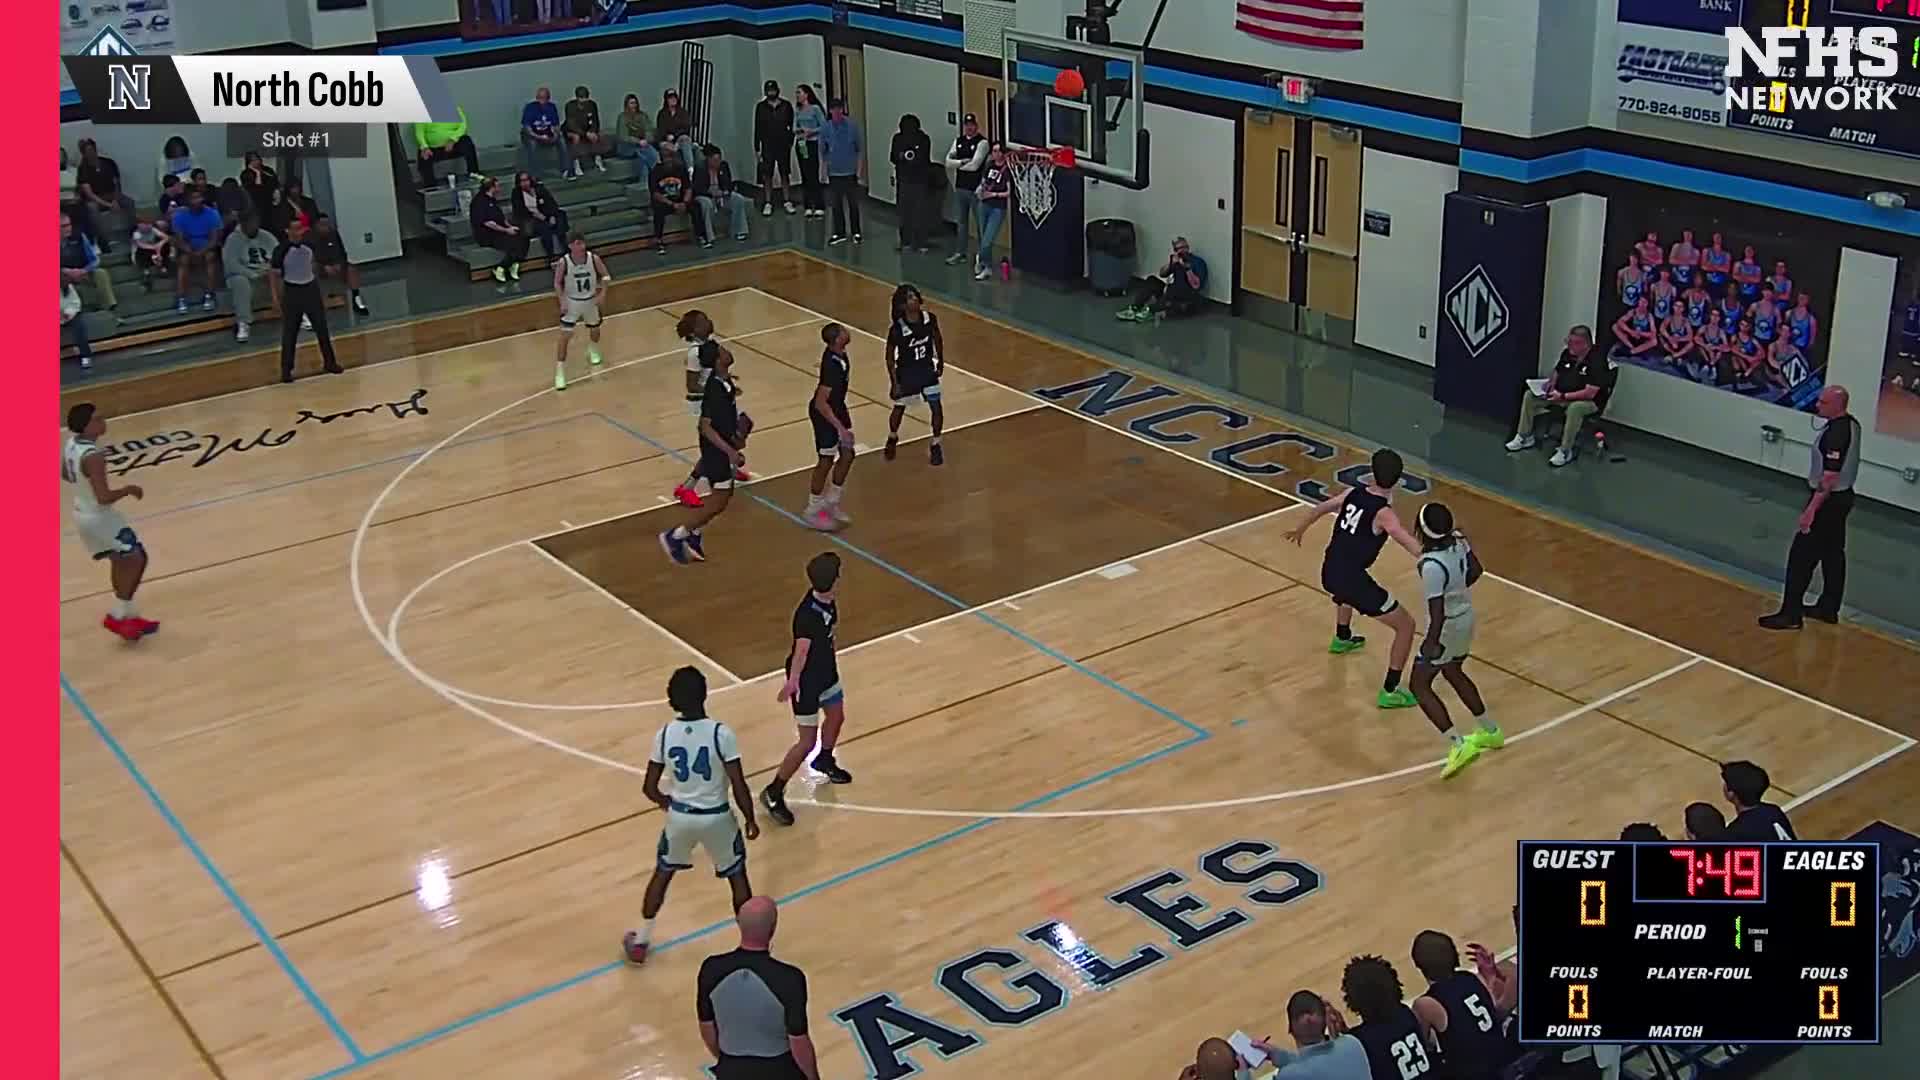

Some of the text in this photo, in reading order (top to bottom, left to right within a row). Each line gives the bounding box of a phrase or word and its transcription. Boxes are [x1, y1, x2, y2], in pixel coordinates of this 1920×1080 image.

[1750, 114, 1794, 131] POINTS
[1829, 127, 1877, 145] MATCH
[576, 278, 591, 293] 14
[914, 345, 926, 361] 12
[1340, 503, 1364, 535] 34
[667, 745, 712, 783] 34
[1464, 993, 1493, 1032] 5
[1390, 1032, 1430, 1080] 23
